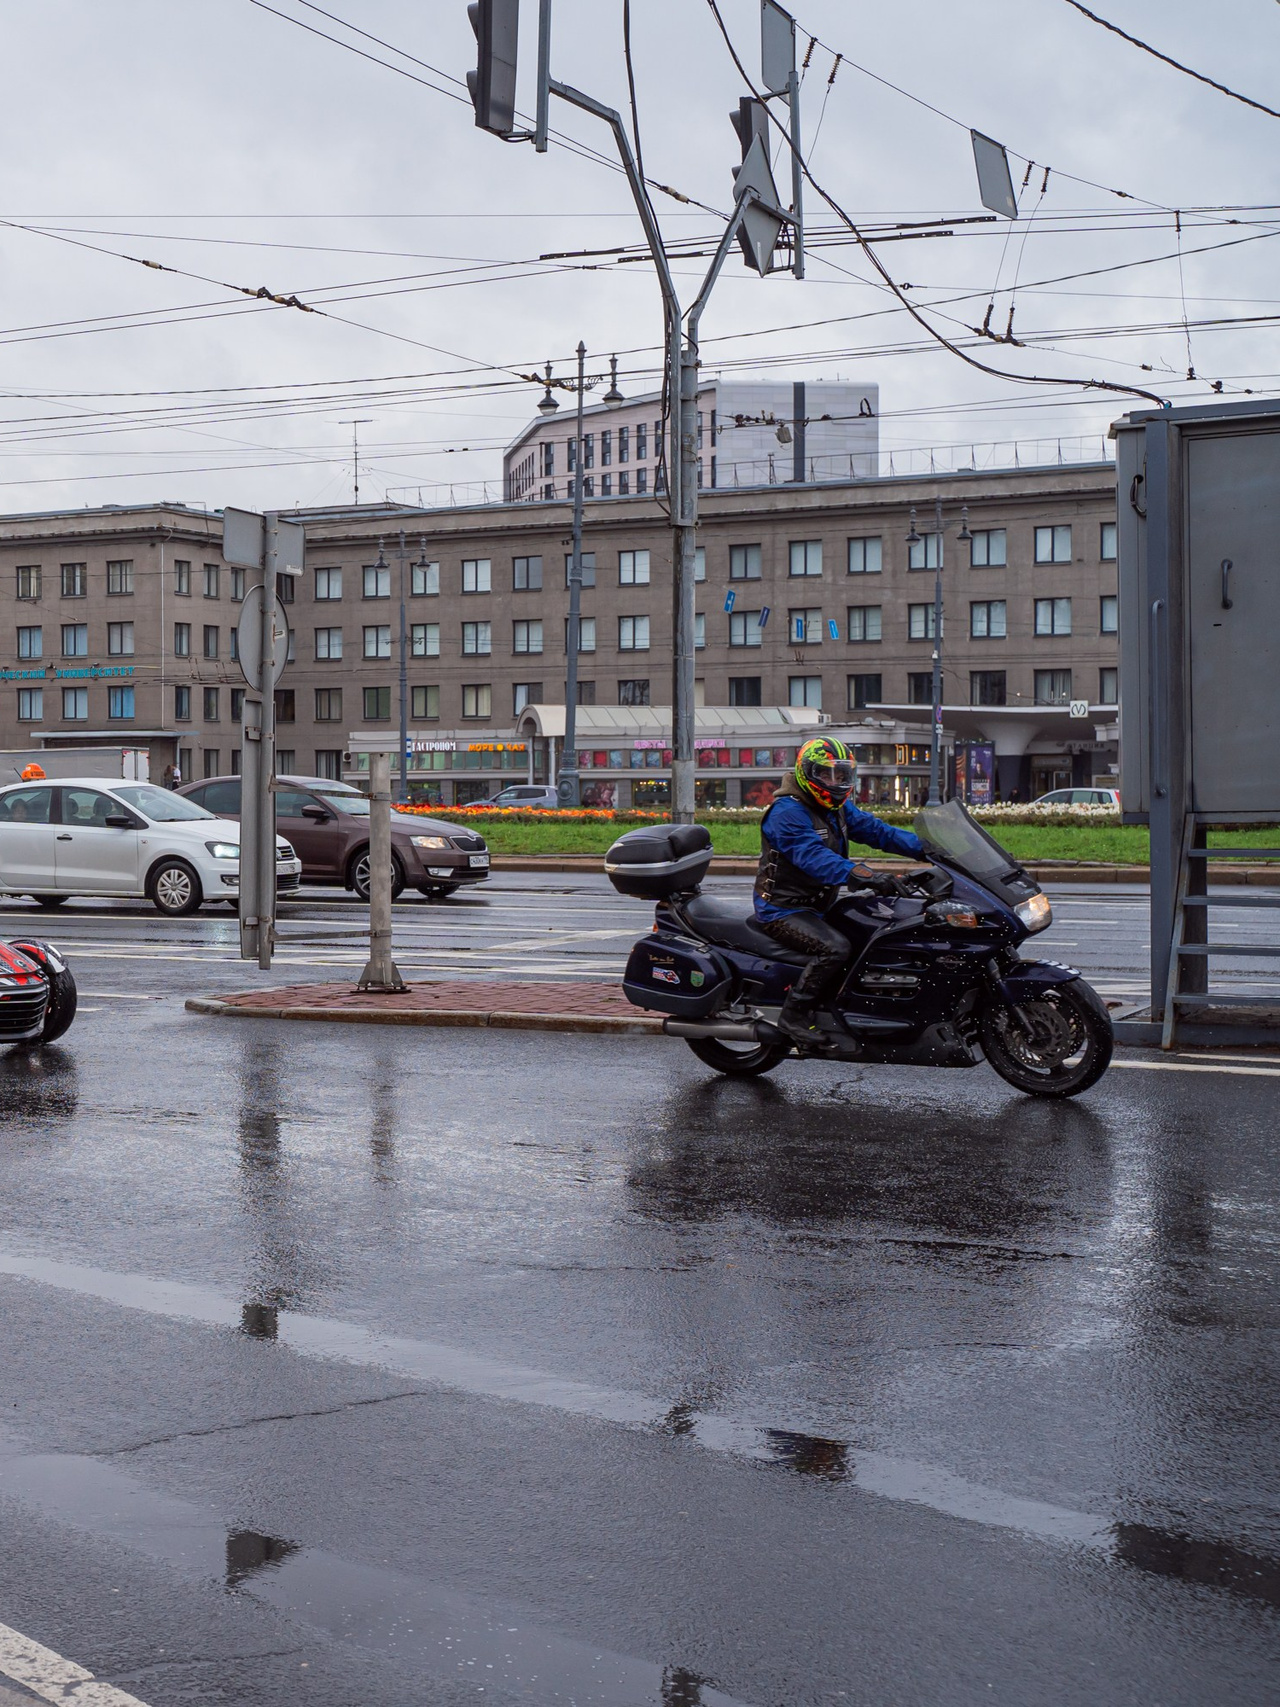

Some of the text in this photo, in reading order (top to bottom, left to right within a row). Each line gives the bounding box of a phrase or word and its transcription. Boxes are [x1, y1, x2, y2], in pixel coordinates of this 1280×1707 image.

[55, 666, 135, 679] УНИВЕРСИТЕТ
[412, 741, 456, 751] ГАСТРОНОМ
[468, 742, 525, 752] МОРЕ ЧАЯ
